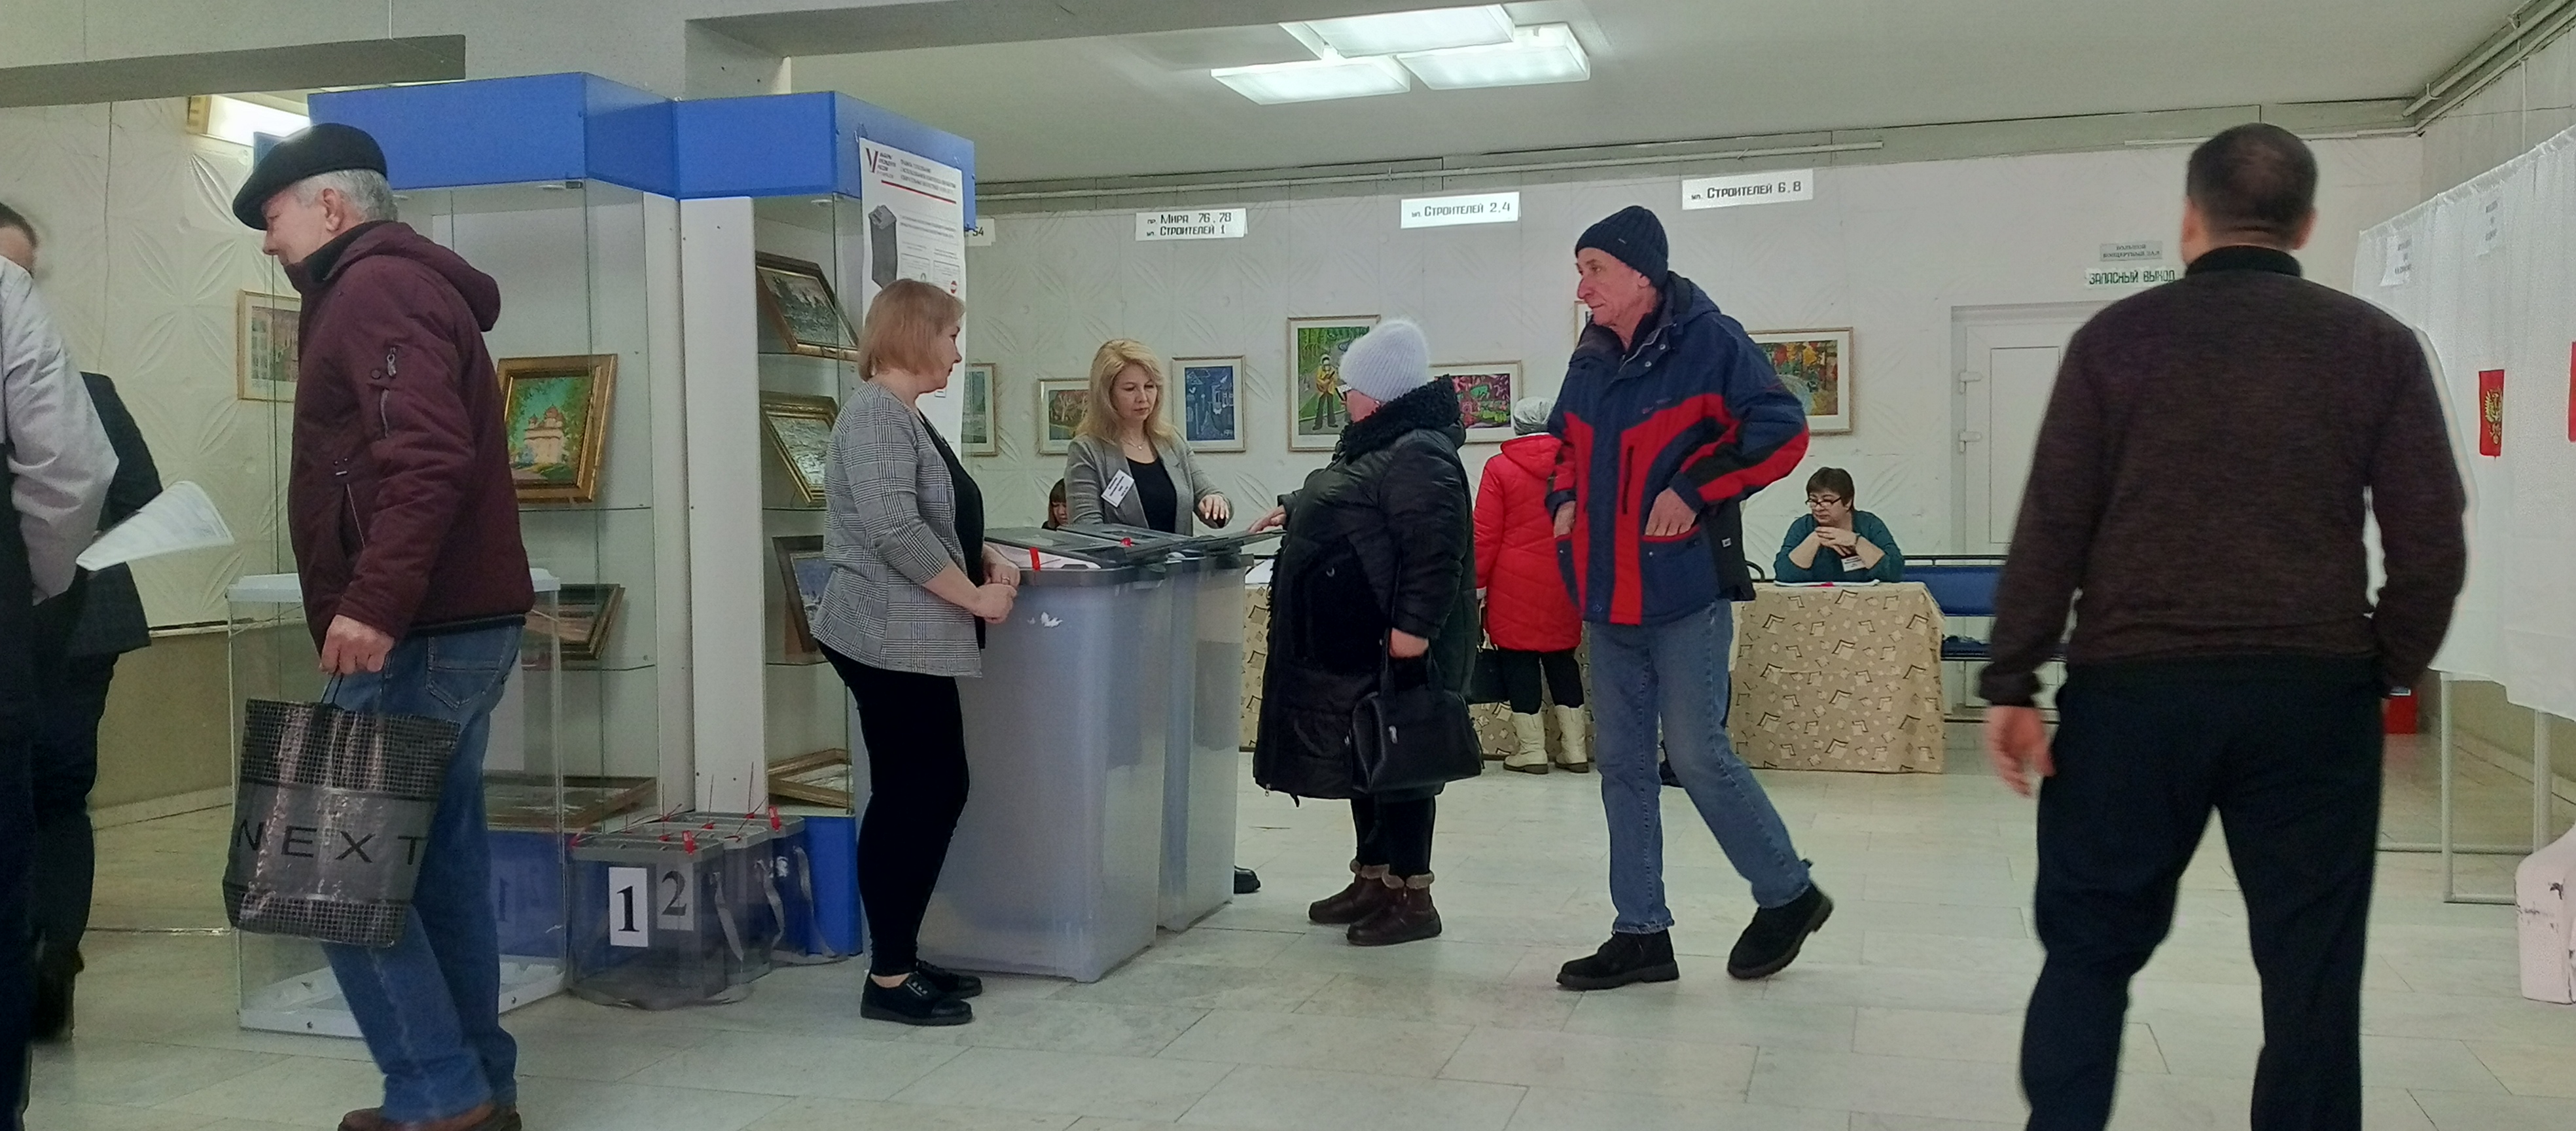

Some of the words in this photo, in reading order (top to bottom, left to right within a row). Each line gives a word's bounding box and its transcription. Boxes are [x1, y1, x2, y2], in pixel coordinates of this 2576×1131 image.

[1160, 213, 1189, 224] МИРА
[2089, 270, 2139, 285] ЗАПАСНЫЙ
[2143, 270, 2175, 283] ВЫХОД
[236, 819, 427, 865] NEXT
[617, 886, 640, 933] 1
[661, 871, 688, 916] 2
